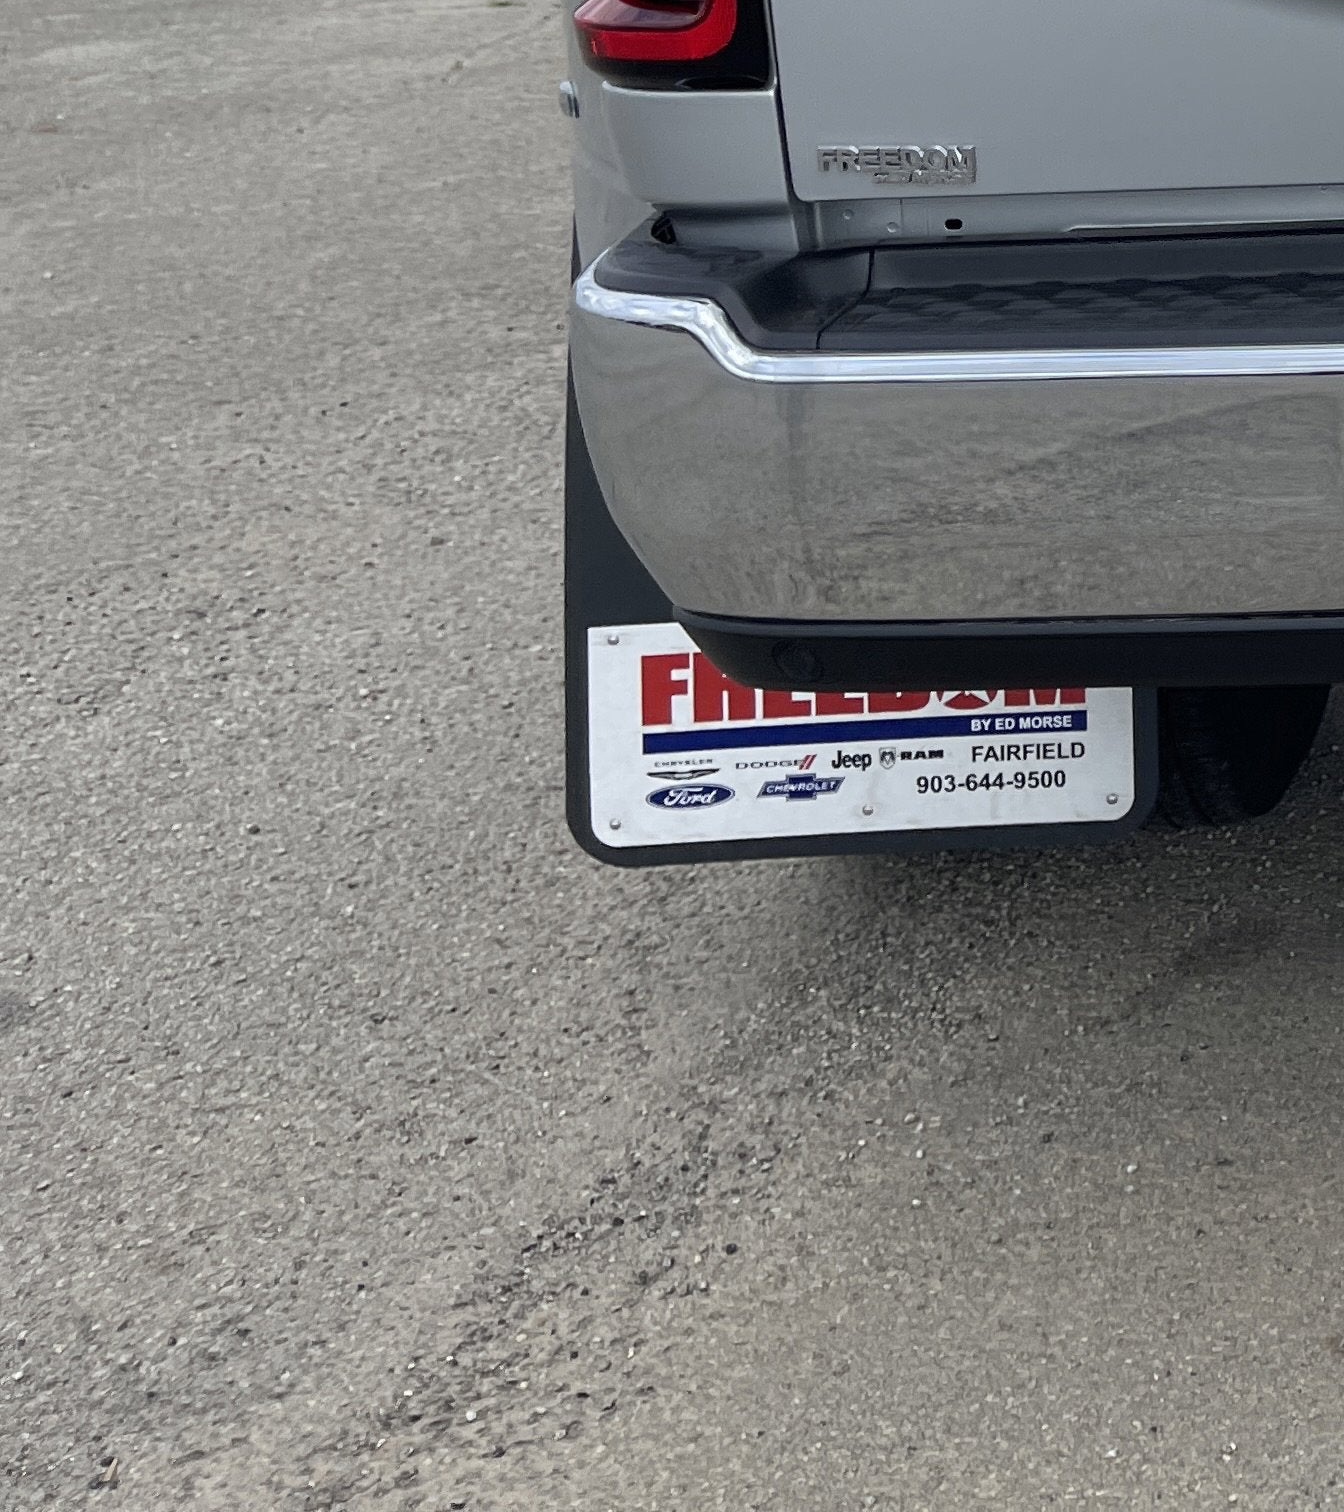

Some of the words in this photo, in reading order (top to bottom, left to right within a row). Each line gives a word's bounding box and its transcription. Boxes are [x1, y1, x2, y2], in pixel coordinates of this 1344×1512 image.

[817, 145, 977, 172] FREEDOM
[971, 718, 990, 732] BY
[995, 717, 1016, 731] ED
[1019, 715, 1072, 730] MORSE
[831, 750, 872, 771] Jeep
[900, 749, 944, 761] RAM
[971, 741, 1086, 763] FAIRFIELD
[654, 758, 713, 767] CHRYSLER
[766, 781, 836, 794] CHEVROLET
[916, 770, 1066, 794] 903-644-9500
[663, 787, 714, 807] Ford
